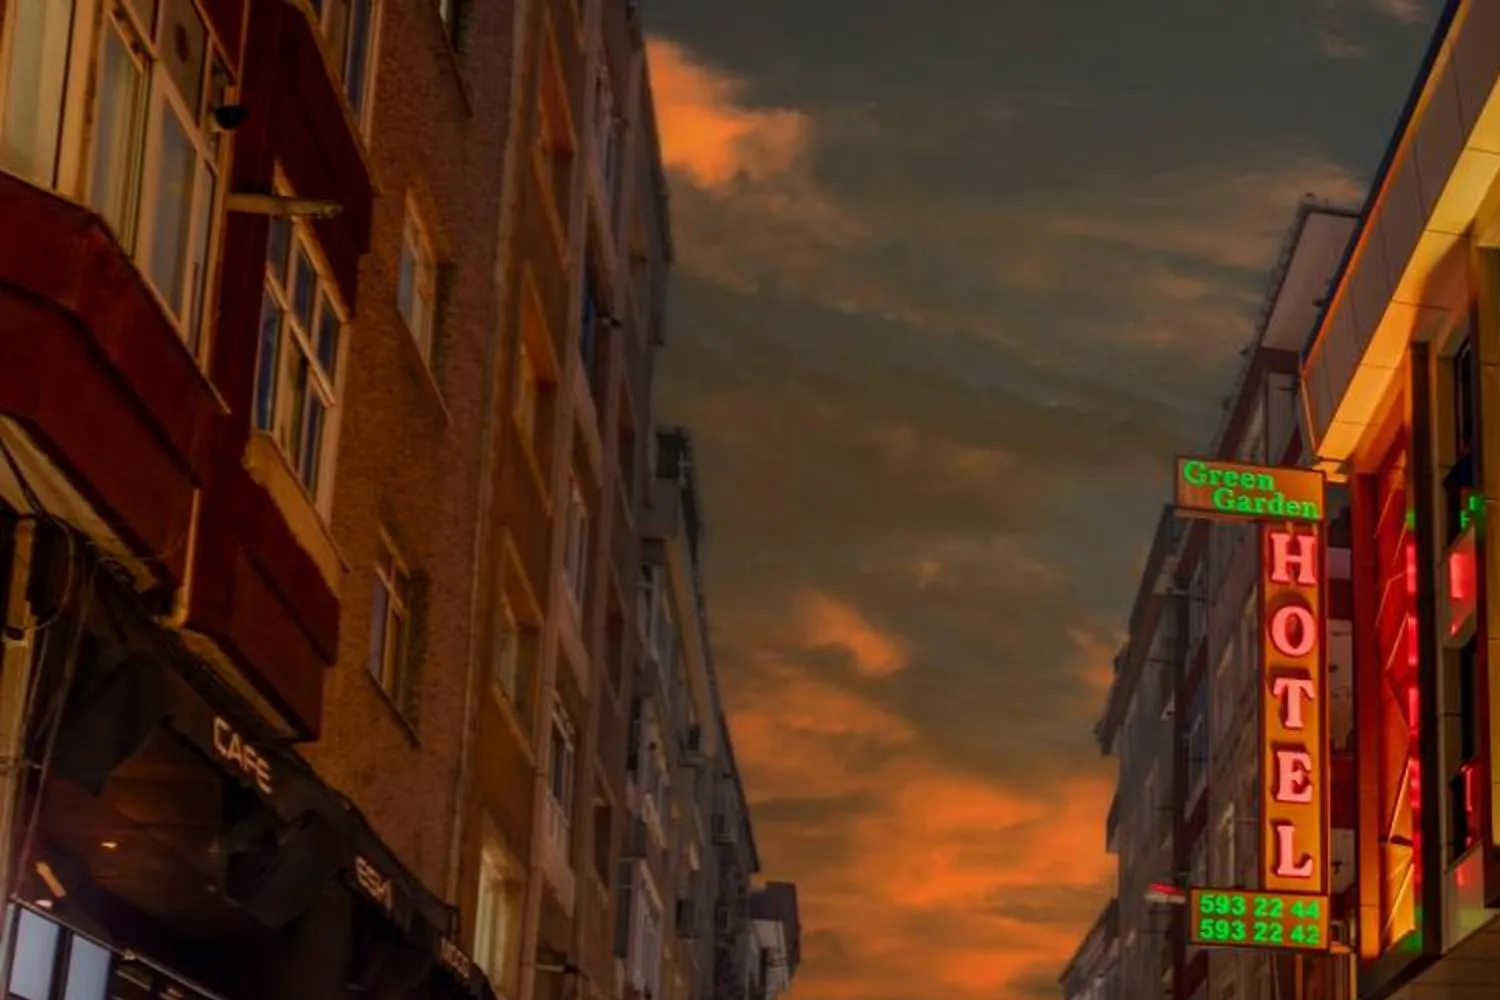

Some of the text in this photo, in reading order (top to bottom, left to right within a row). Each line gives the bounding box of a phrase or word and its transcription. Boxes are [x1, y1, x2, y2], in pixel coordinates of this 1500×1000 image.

[1183, 459, 1275, 491] Green
[1212, 486, 1320, 520] Garden
[1269, 532, 1317, 878] HOTEL
[213, 715, 273, 795] CAFE
[1199, 893, 1320, 919] 593 22 44
[1199, 918, 1320, 945] 593 22 42
